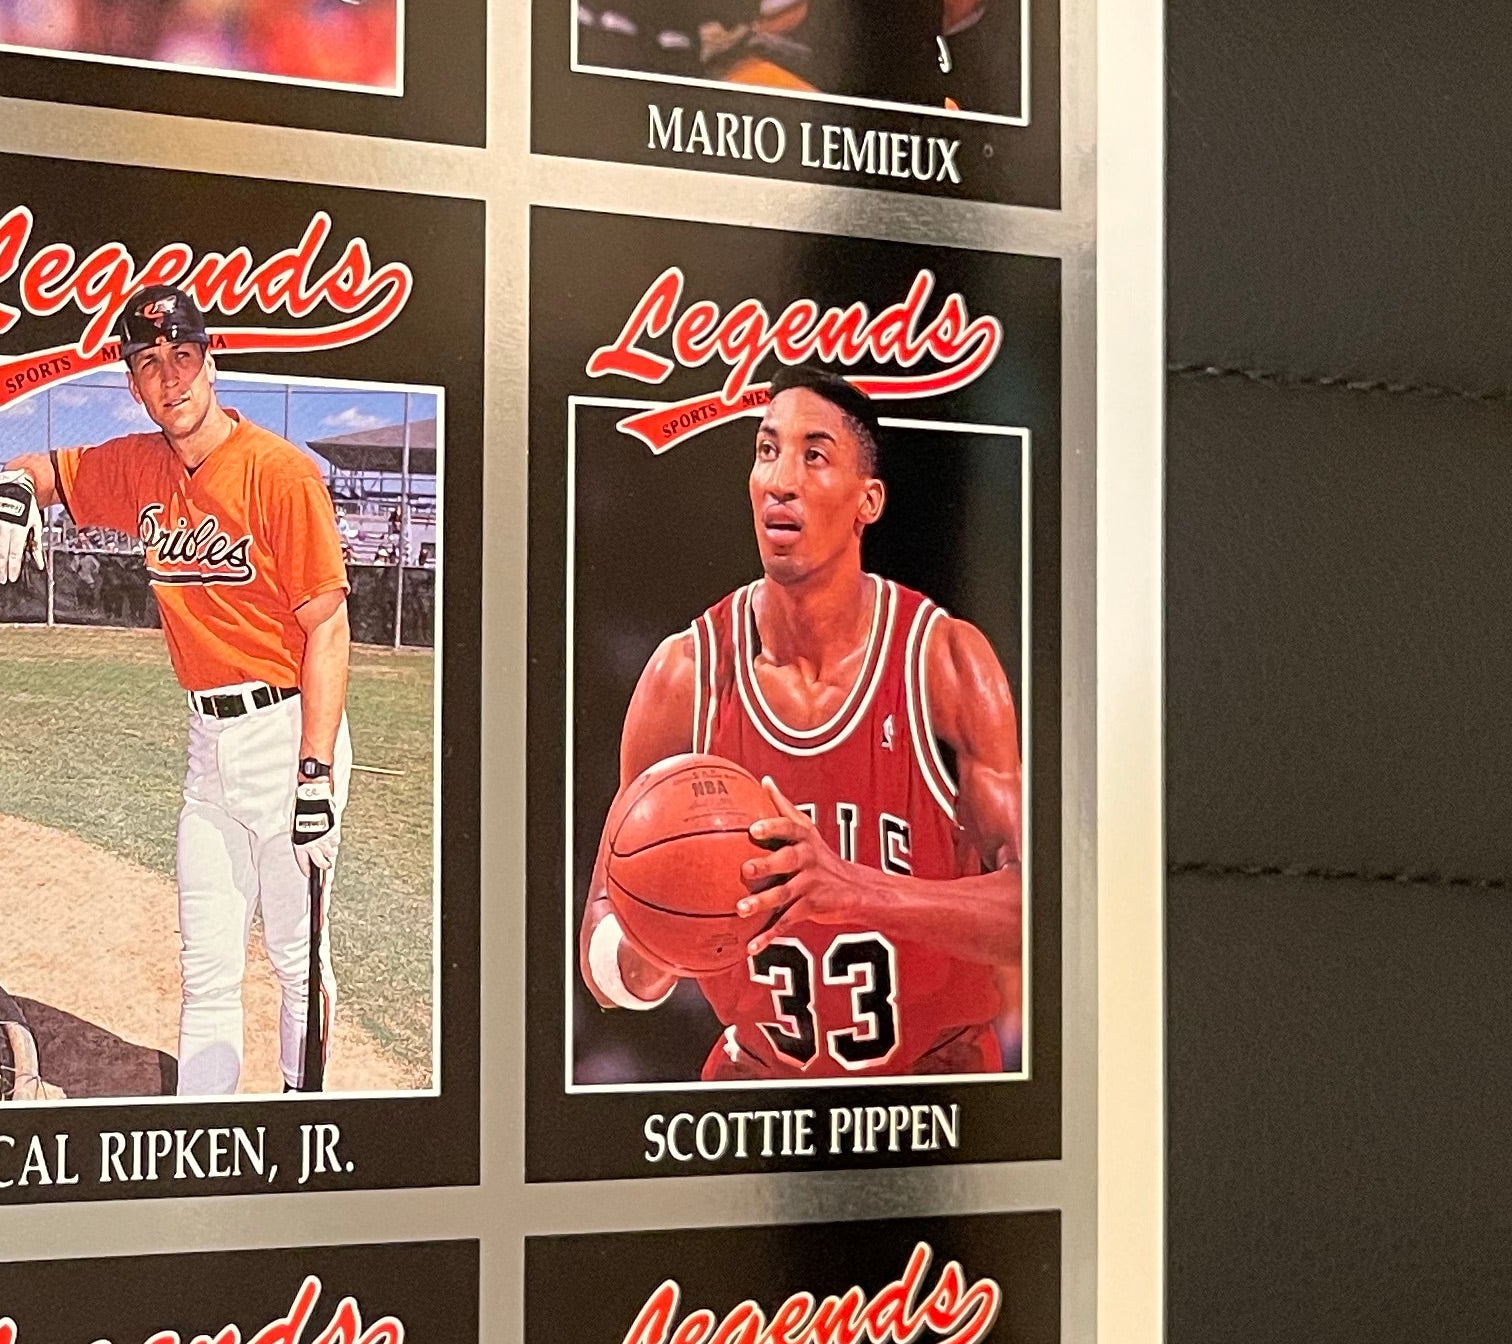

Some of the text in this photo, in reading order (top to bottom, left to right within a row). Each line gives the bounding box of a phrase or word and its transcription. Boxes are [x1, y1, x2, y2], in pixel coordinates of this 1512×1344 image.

[648, 104, 961, 184] MARIO LEMIEUX
[586, 266, 1003, 403] Legends
[5, 355, 72, 394] SPORTS
[662, 403, 718, 438] SPORTS
[691, 780, 728, 797] NBA
[749, 932, 901, 1071] 33
[100, 1126, 279, 1183] RIPKEN,
[297, 1123, 355, 1185] JR.
[644, 1104, 960, 1163] SCOTTIE PIPPEN
